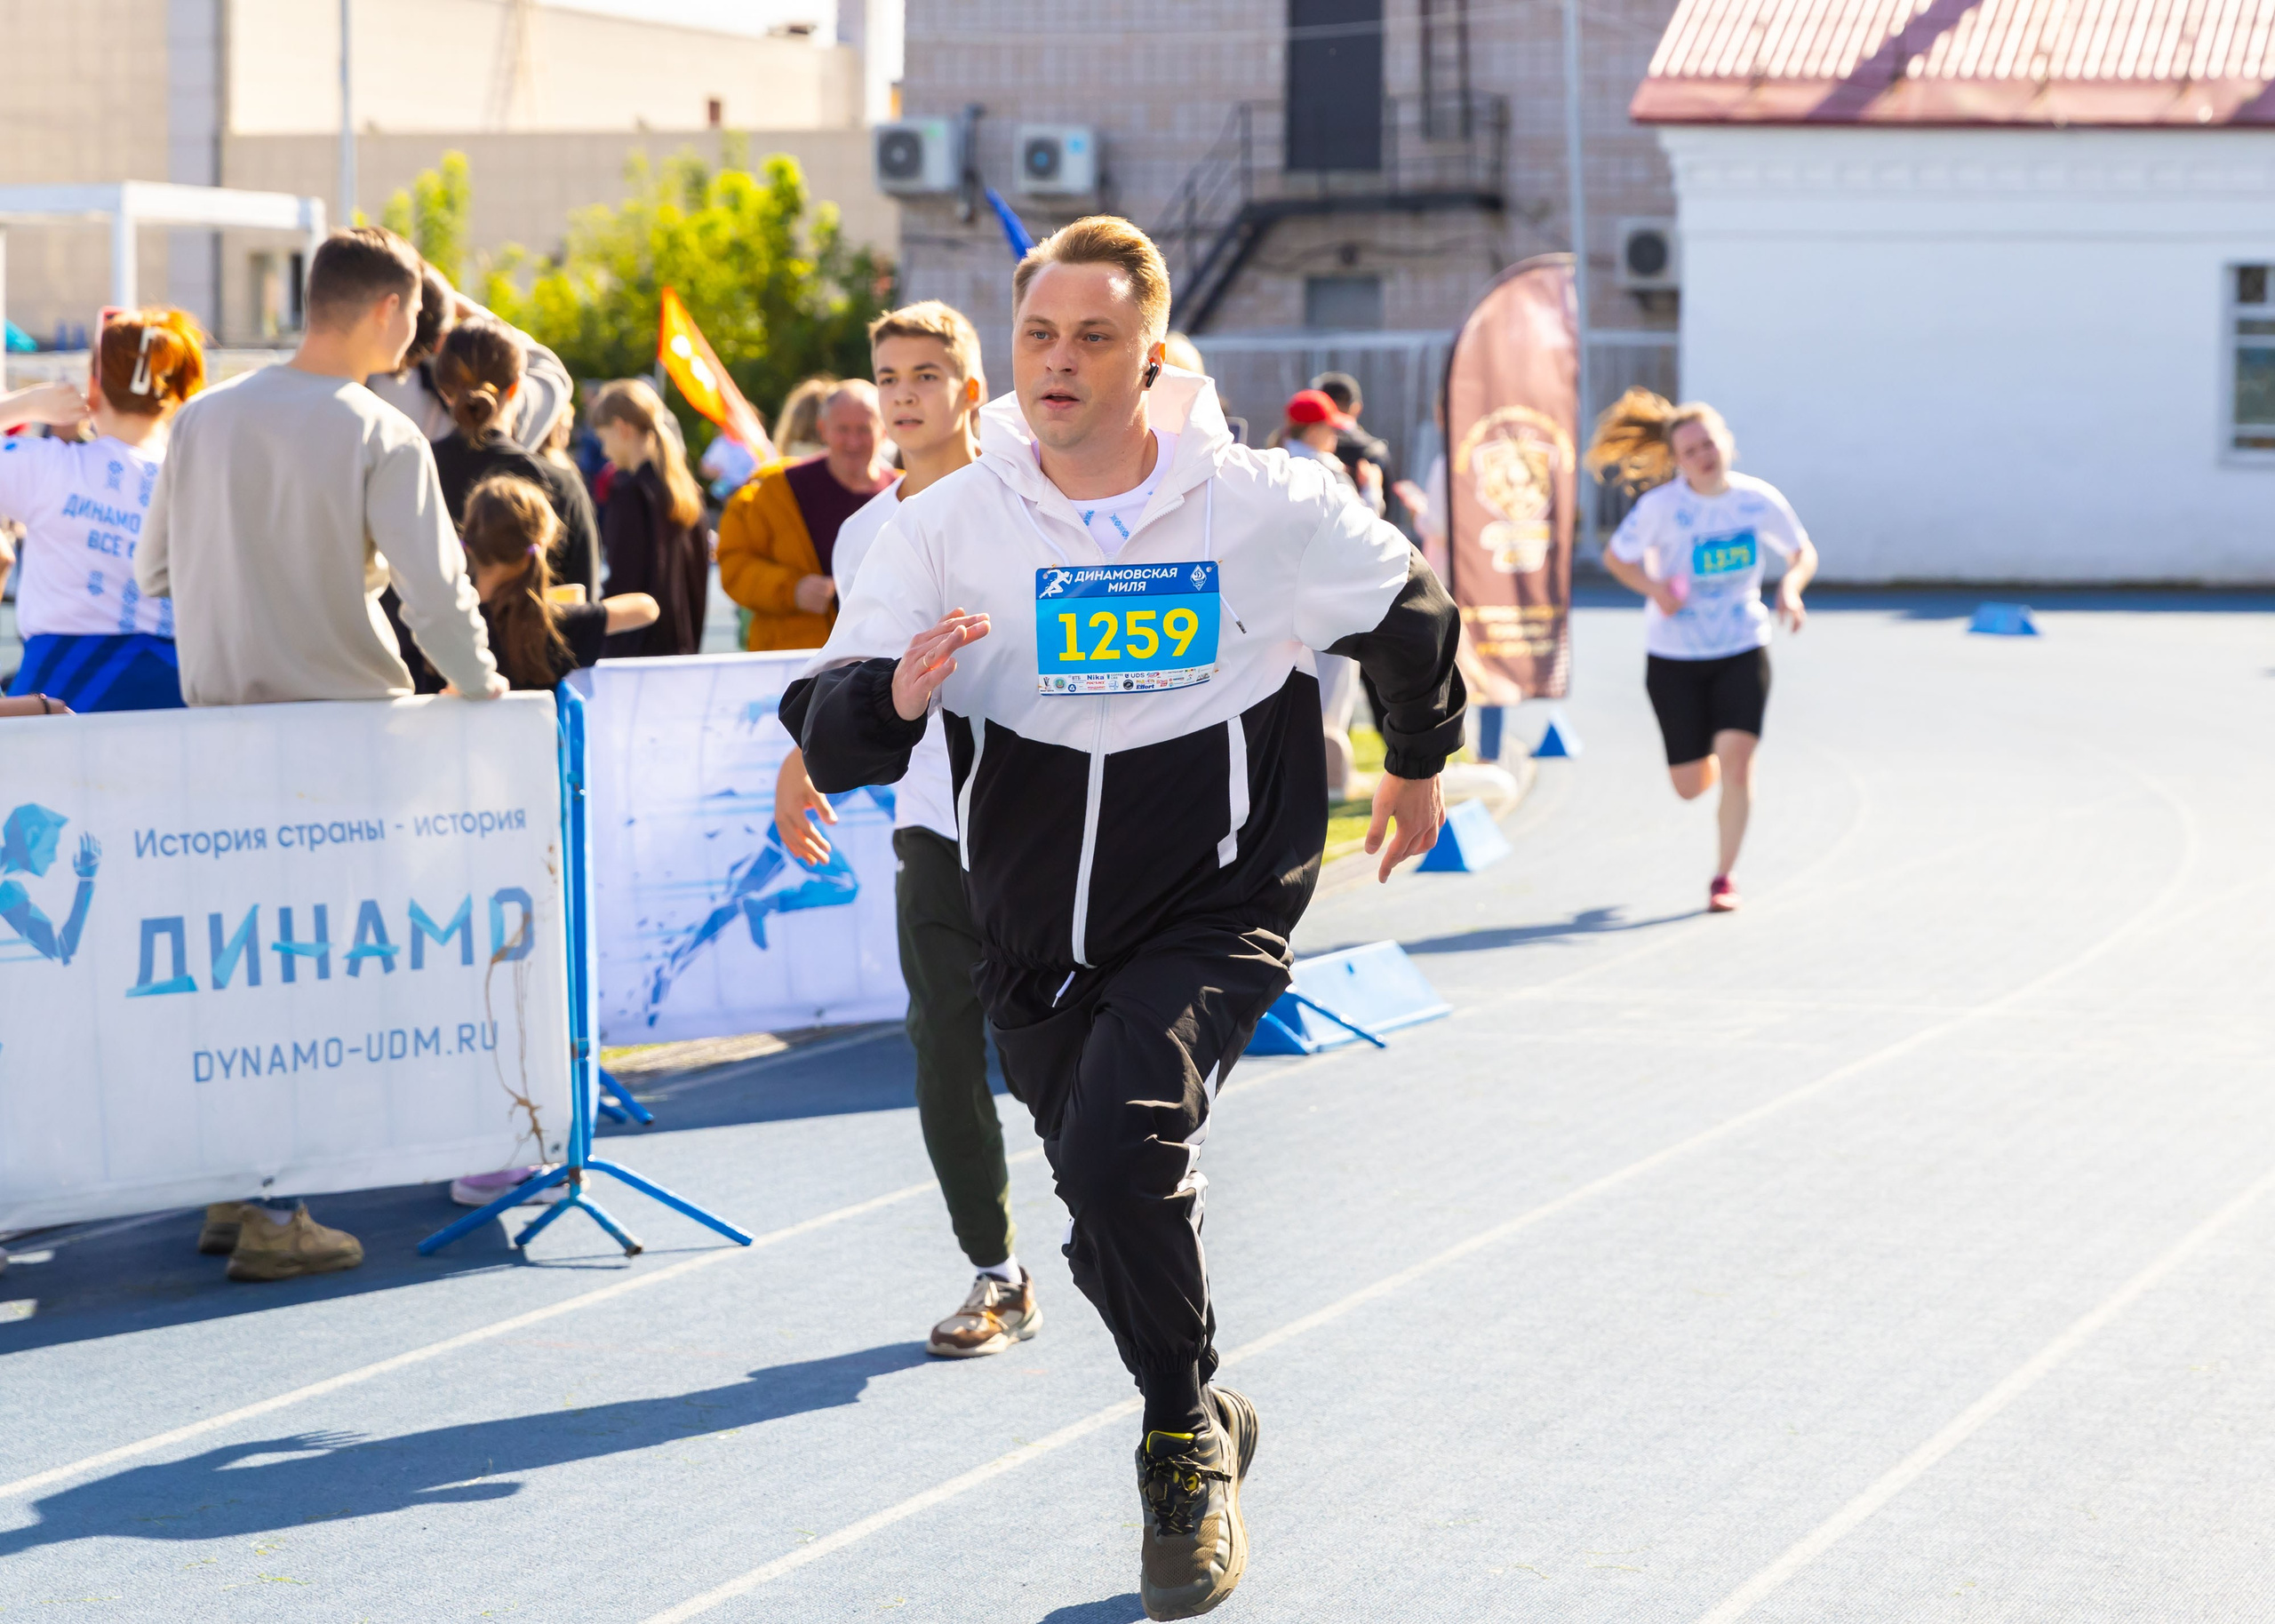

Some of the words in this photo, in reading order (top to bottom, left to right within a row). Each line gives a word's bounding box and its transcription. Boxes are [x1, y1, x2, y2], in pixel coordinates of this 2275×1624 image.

[87, 529, 123, 557] ВСЕ
[1074, 568, 1177, 583] ДИНАМОВСКАЯ
[1107, 581, 1146, 593] МИЛЯ
[1058, 608, 1199, 661] 1259
[133, 827, 267, 859] История
[277, 818, 386, 851] страны
[414, 808, 527, 838] история
[124, 887, 535, 999] ДИНАМО
[193, 1021, 499, 1083] DYNAMO-UDM.RU
